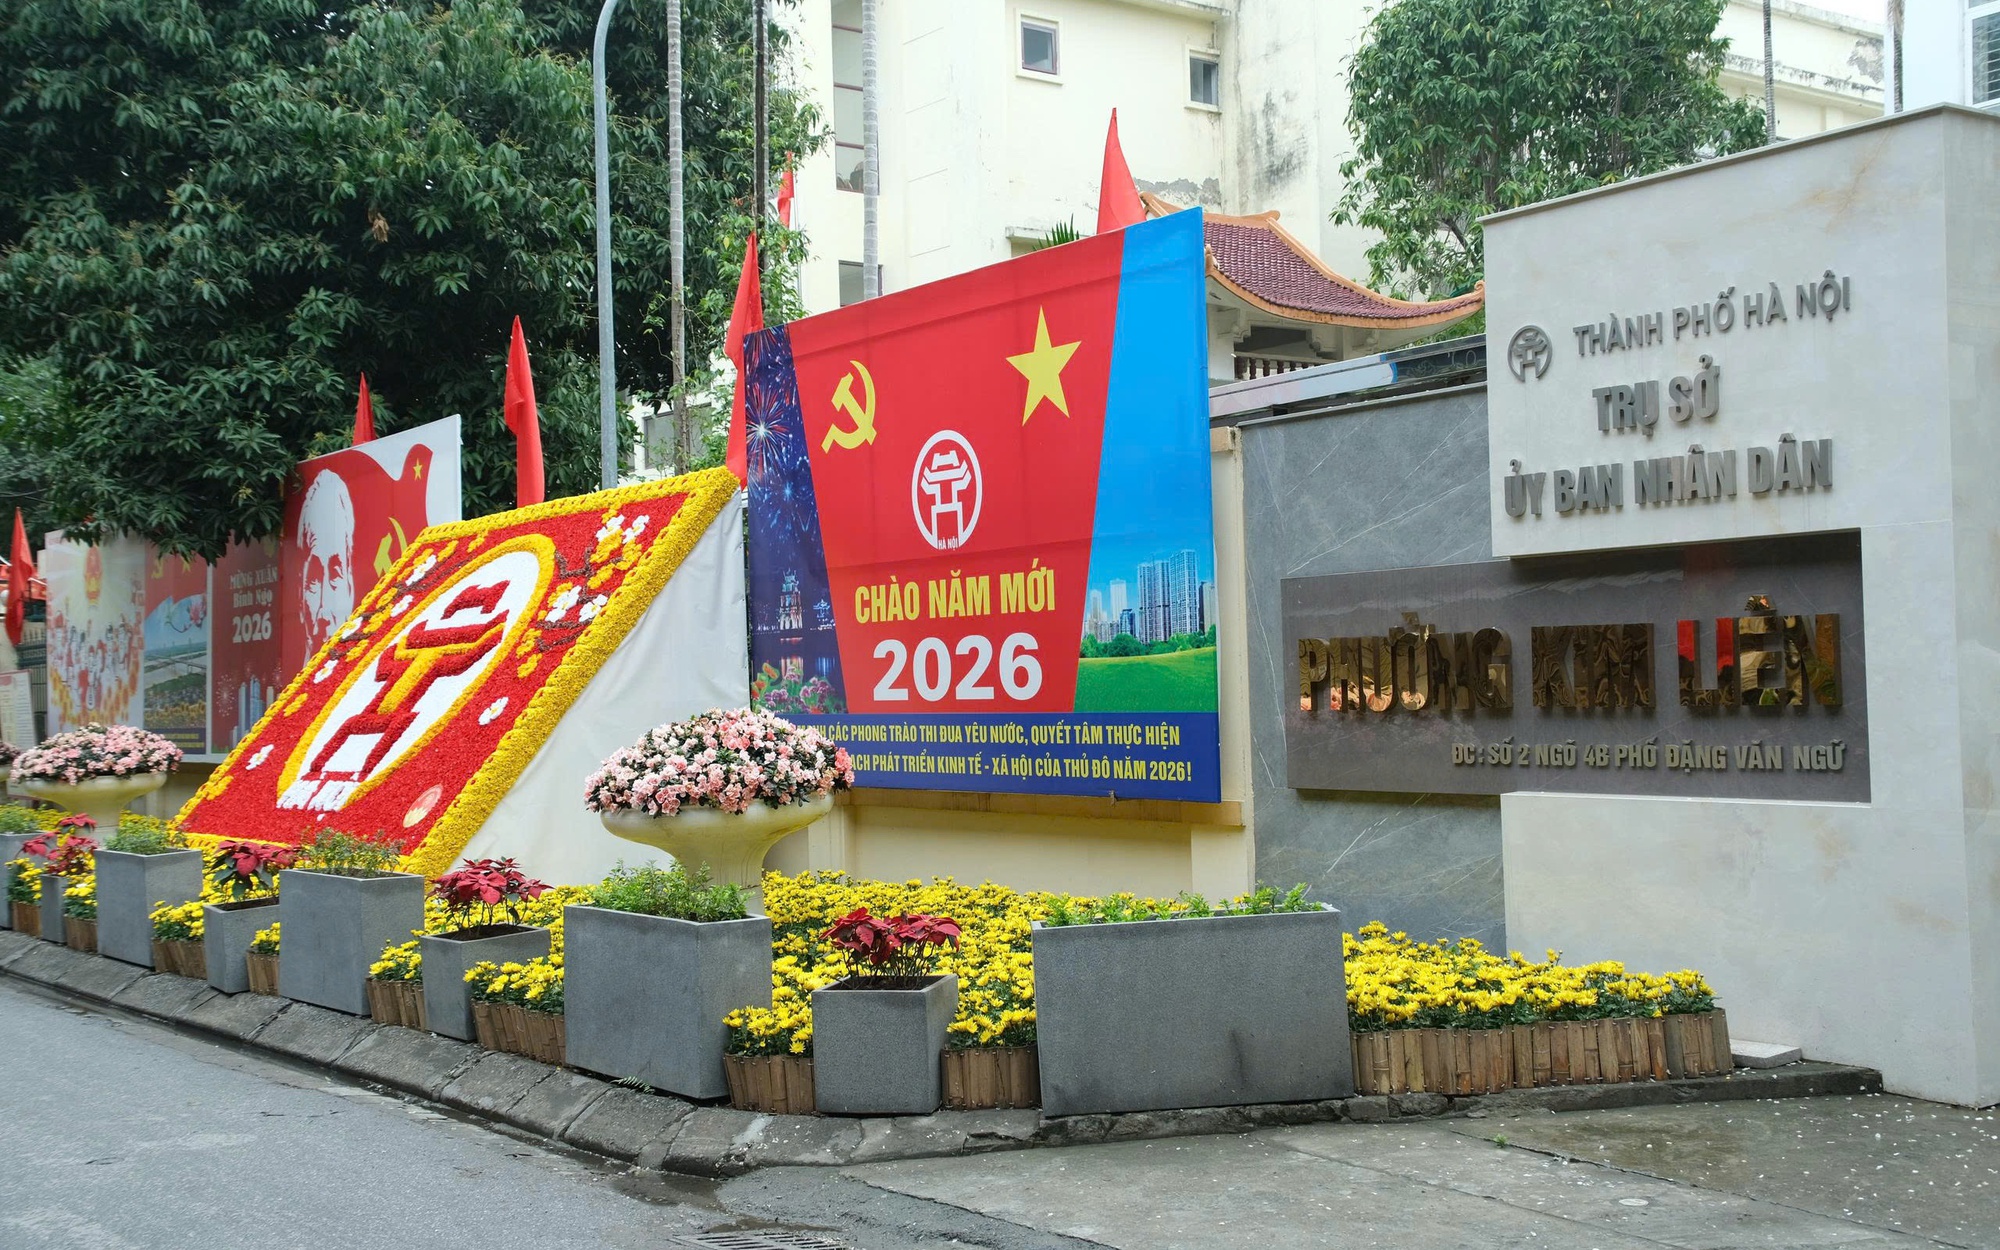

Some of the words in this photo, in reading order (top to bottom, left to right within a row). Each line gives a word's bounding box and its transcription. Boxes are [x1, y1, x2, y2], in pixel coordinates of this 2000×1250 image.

[1573, 313, 1663, 356] THÀNH
[1672, 286, 1735, 339] PHỐ
[1743, 282, 1787, 328] HÀ
[1796, 270, 1850, 321] NỘI
[1592, 380, 1660, 438] TRỤ
[1668, 354, 1721, 423] SỞ
[1504, 459, 1547, 517] ỦY
[1553, 463, 1623, 513] BAN
[1633, 444, 1737, 505] NHÂN
[1747, 433, 1833, 493] DÂN
[938, 536, 947, 550] HÀ
[947, 535, 959, 551] NỘI
[855, 575, 920, 624] CHÀO
[928, 569, 991, 619] NĂM
[1000, 558, 1056, 614] MỚI
[232, 611, 272, 644] 2026
[1298, 612, 1513, 712] PHƯỜNG
[1531, 623, 1656, 708] KIM
[1676, 594, 1843, 706] LIÊN
[873, 632, 1043, 702] 2026
[828, 721, 849, 741] CÁC
[851, 725, 887, 742] PHONG
[889, 721, 917, 742] TRÀO
[919, 725, 937, 743] THI
[940, 724, 963, 743] ĐUA
[964, 721, 987, 743] YÊU
[990, 721, 1029, 746] NƯỚC,
[1031, 719, 1071, 744] QUYẾT
[1074, 721, 1103, 745] TÂM
[1106, 723, 1142, 749] THỰC
[1145, 721, 1180, 750] HIỆN
[873, 751, 900, 772] PHÁT
[902, 749, 935, 773] TRIỂN
[937, 756, 966, 774] KINH
[968, 751, 982, 775] TẾ
[992, 754, 1009, 776] XÃ
[1011, 754, 1032, 780] HỘI
[1035, 752, 1062, 777] CỦA
[1063, 752, 1088, 778] THỦ
[1091, 755, 1110, 779] ĐÔ
[1113, 755, 1147, 780] NĂM
[1149, 761, 1192, 782] 2026!
[1487, 736, 1514, 765] SỐ
[1517, 743, 1531, 765] 2
[1535, 738, 1577, 767] NGÕ
[1583, 743, 1610, 767] 4B
[1614, 735, 1659, 768] PHỐ
[1664, 738, 1728, 773] ĐẶNG
[1733, 739, 1783, 770] VĂN
[1793, 738, 1847, 771] NGỮ
